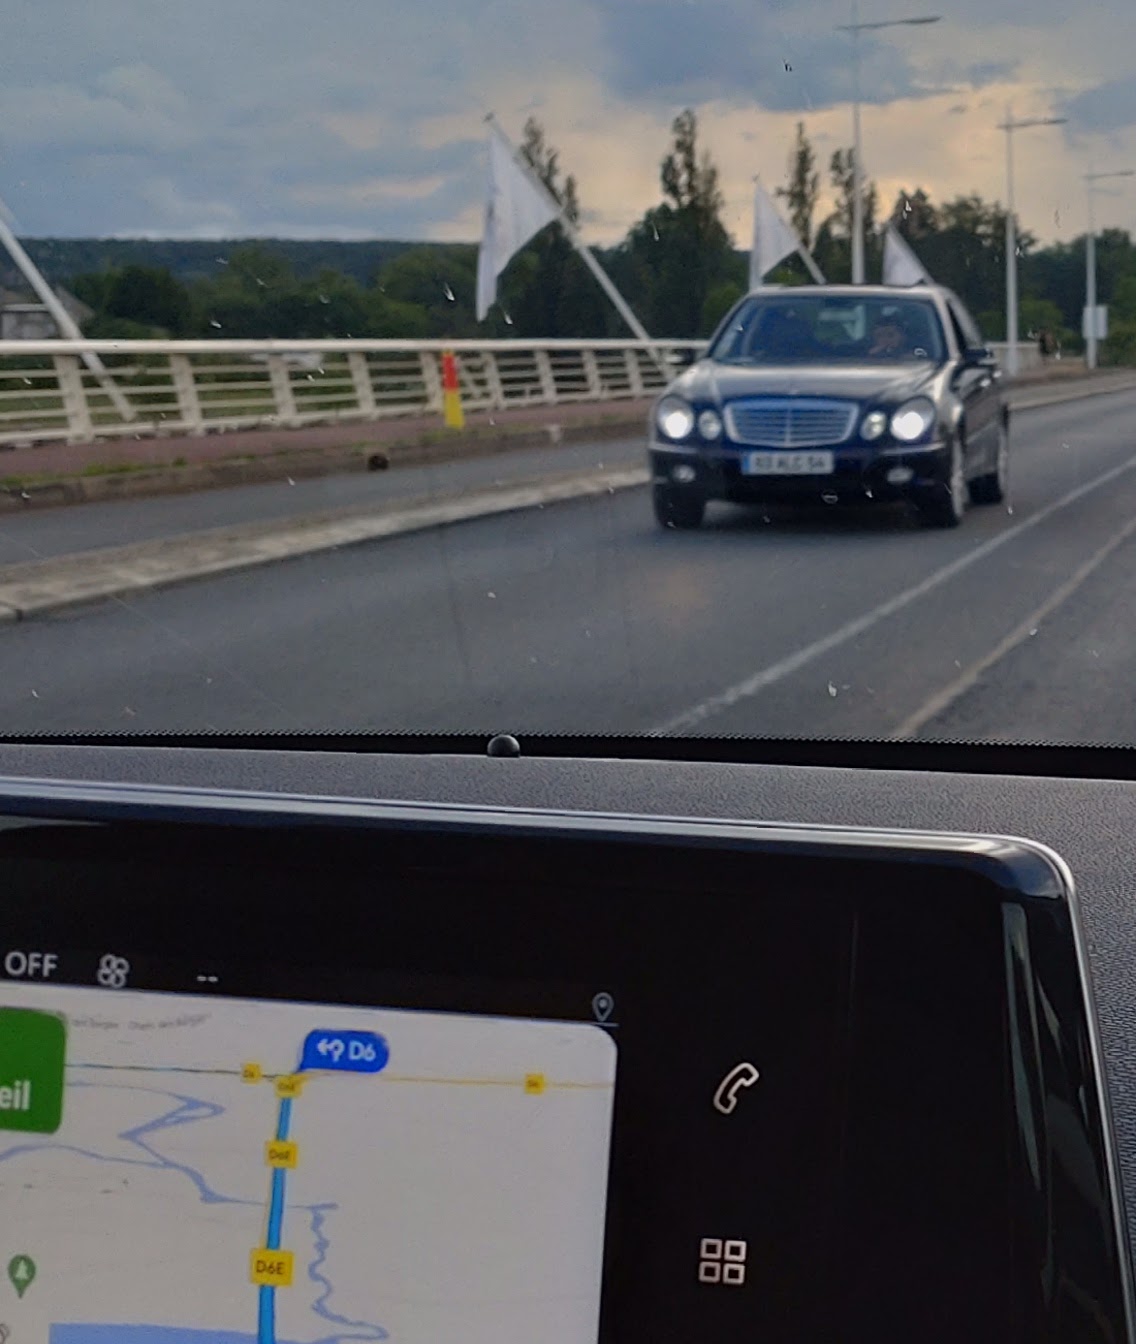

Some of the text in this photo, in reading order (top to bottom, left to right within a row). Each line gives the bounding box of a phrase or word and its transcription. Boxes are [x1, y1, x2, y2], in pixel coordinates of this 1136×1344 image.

[4, 951, 58, 977] OFF
[348, 1040, 377, 1062] D6
[256, 1259, 285, 1275] D6E
